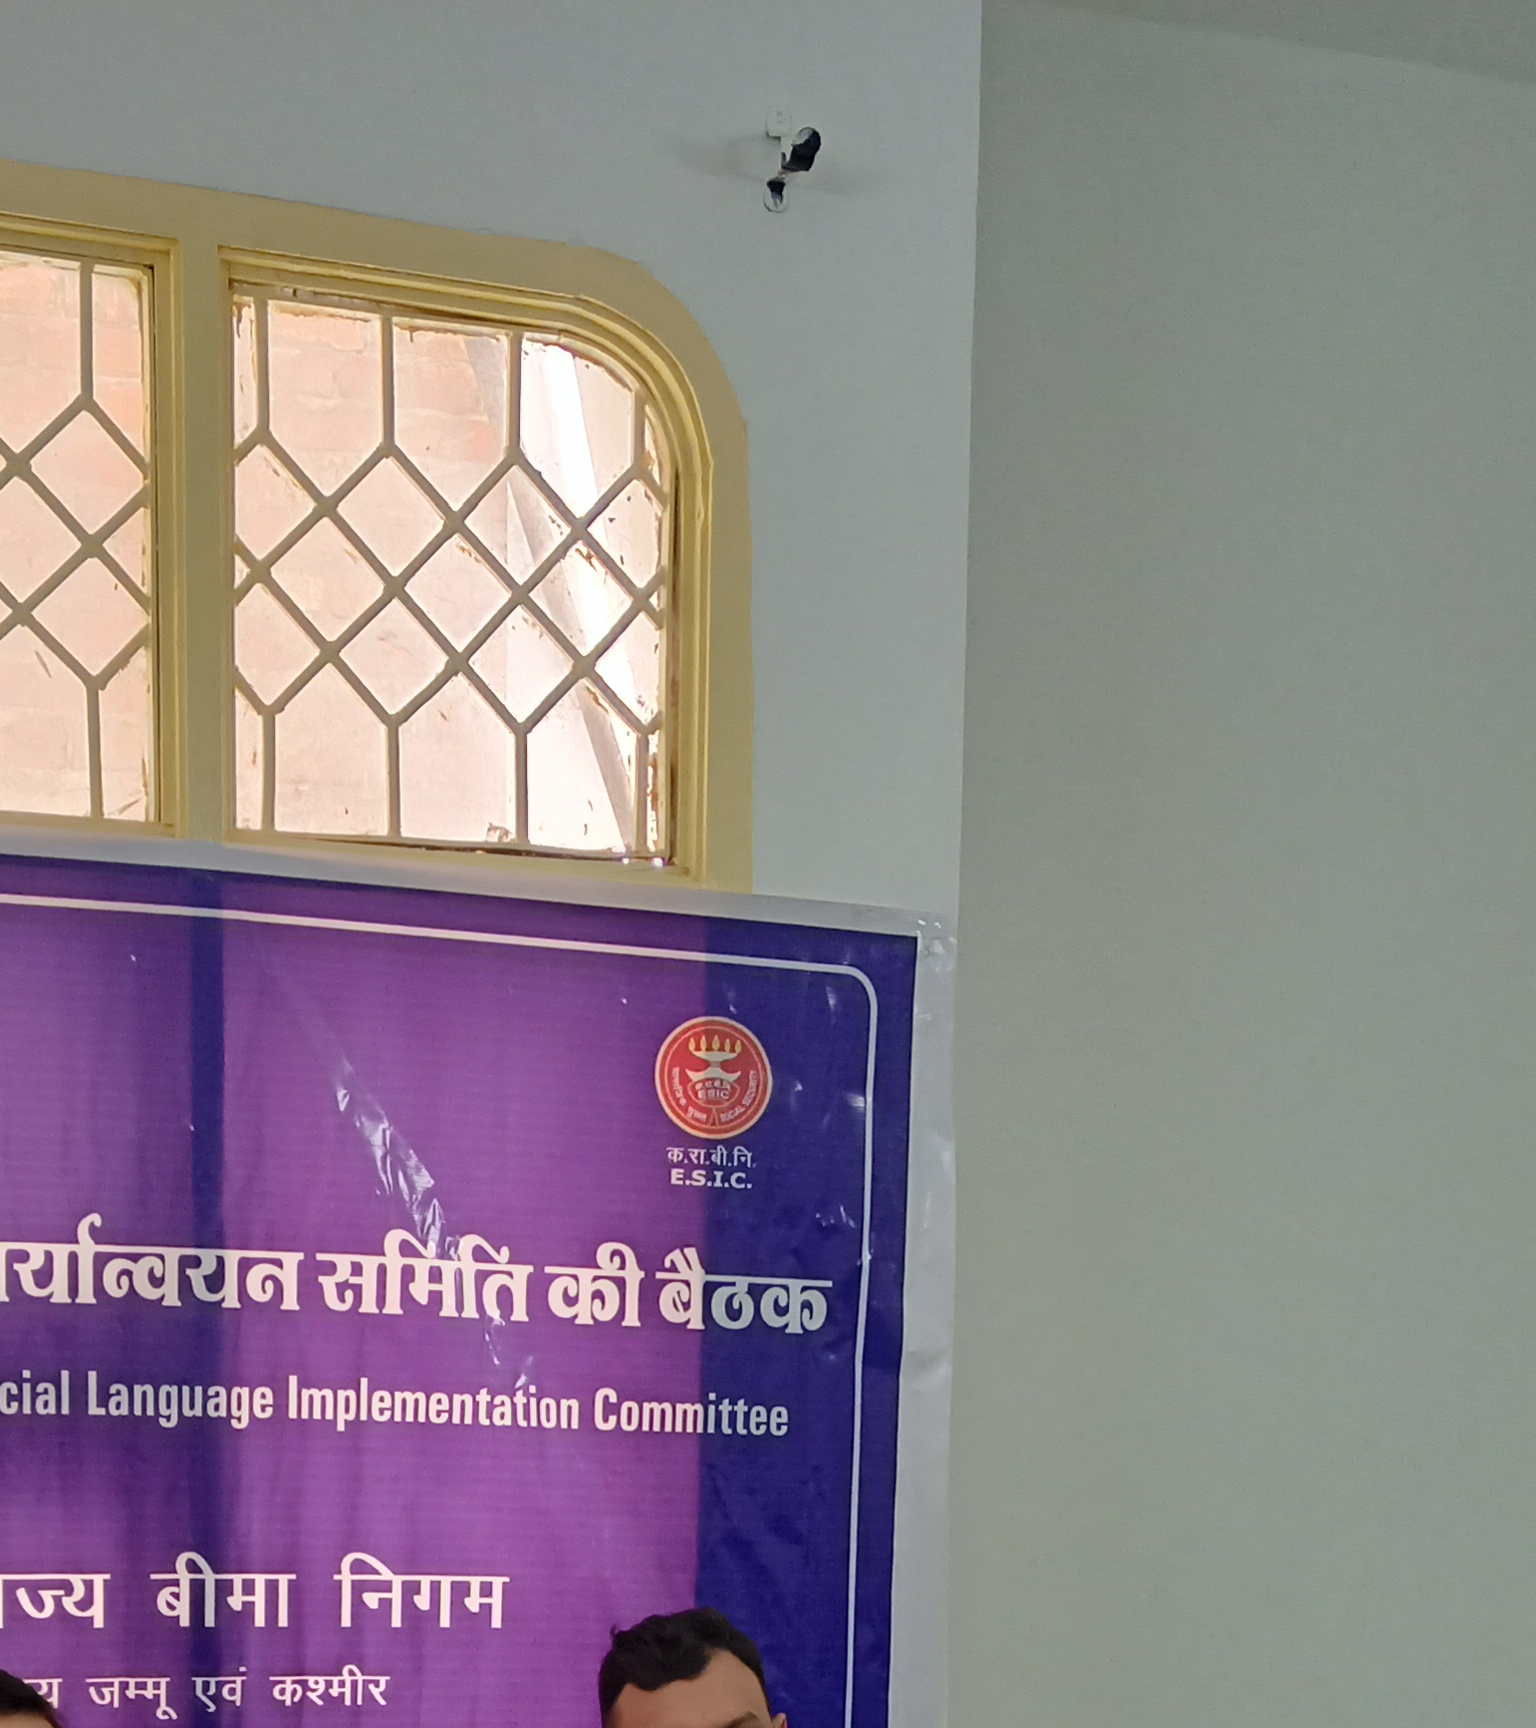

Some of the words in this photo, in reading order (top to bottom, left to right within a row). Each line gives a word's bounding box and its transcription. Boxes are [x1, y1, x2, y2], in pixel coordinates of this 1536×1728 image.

[671, 1169, 752, 1188] E.S.I.C.
[316, 1228, 533, 1321] समिति
[544, 1242, 644, 1326] की
[656, 1248, 832, 1333] बैठक
[88, 1371, 273, 1429] Language
[289, 1375, 578, 1431] Implementation
[595, 1388, 787, 1435] Committee
[150, 1552, 296, 1627] बीमा
[334, 1553, 509, 1628] निगम
[86, 1678, 177, 1719] जम्मू
[192, 1667, 247, 1712] एवं
[270, 1665, 390, 1706] कश्मीर
